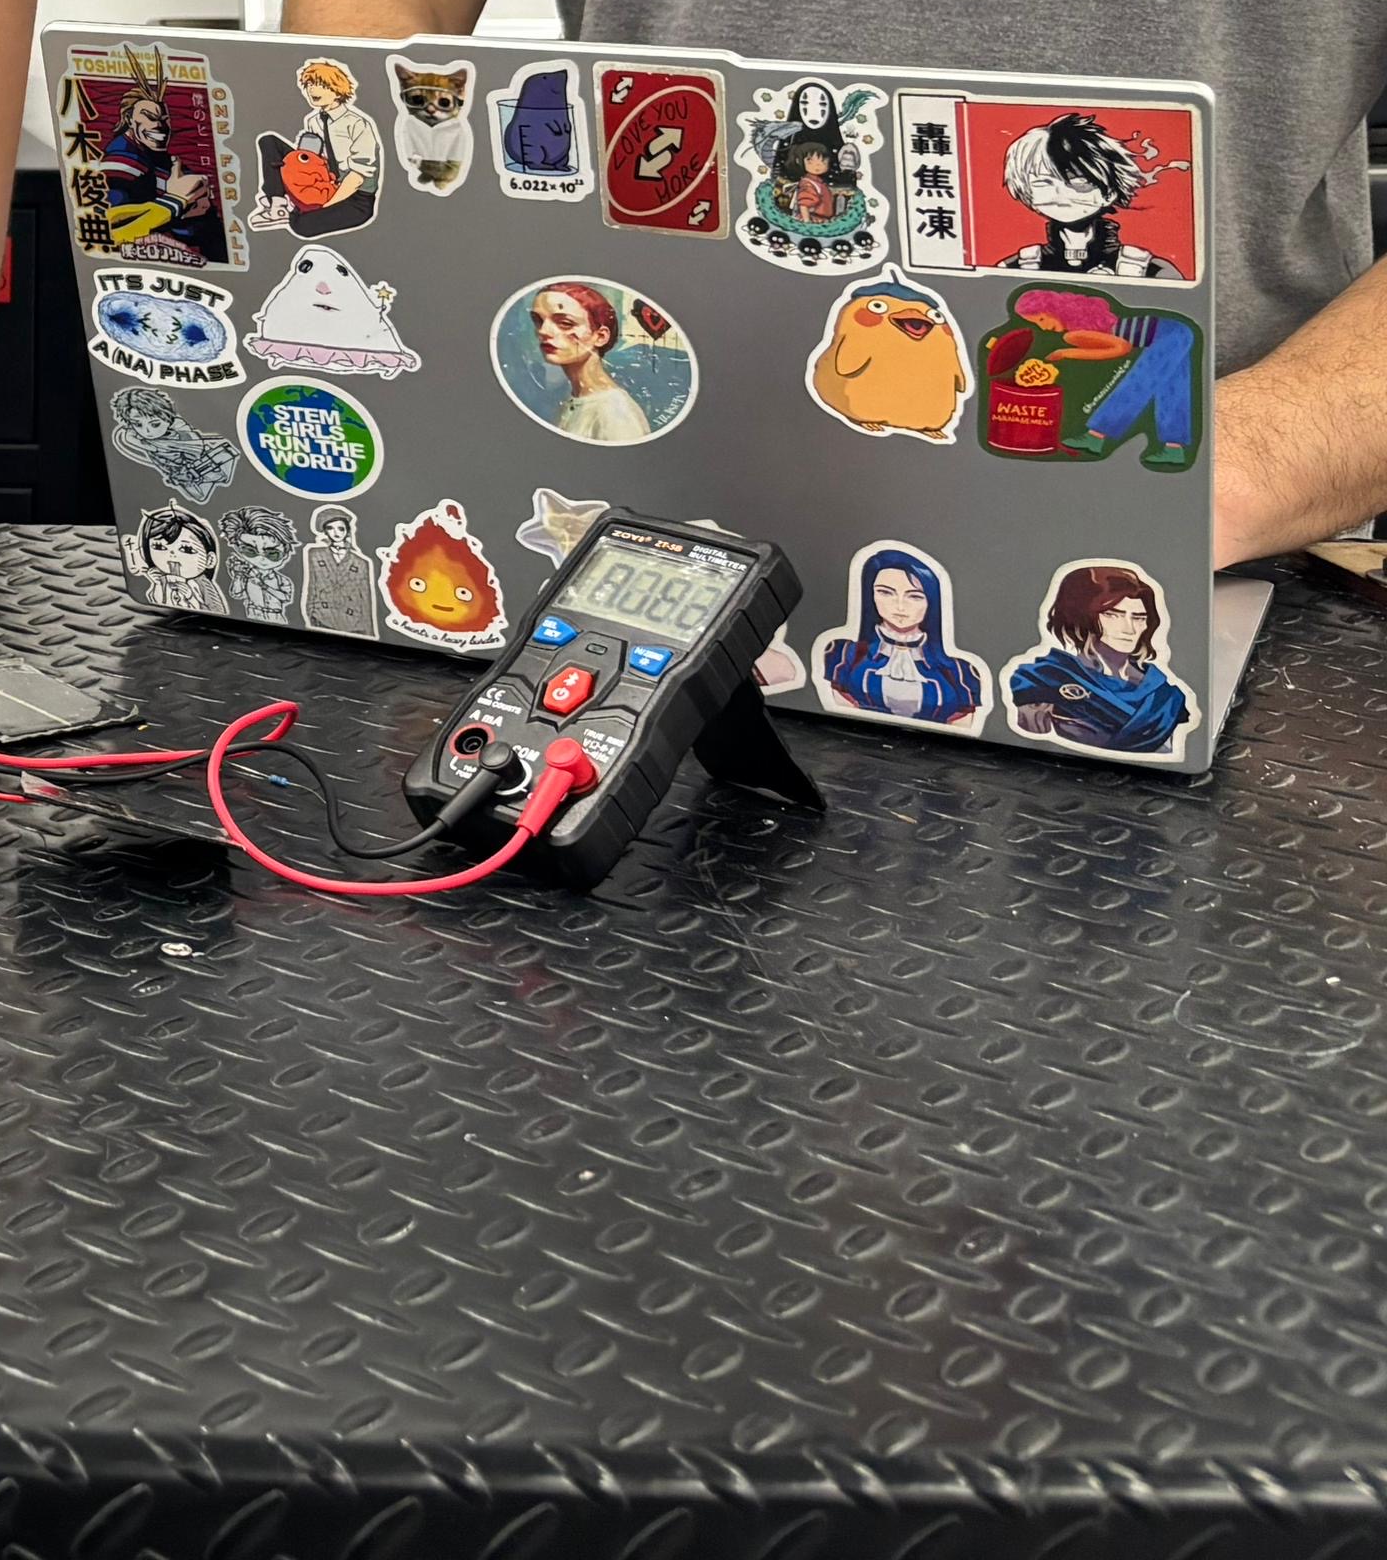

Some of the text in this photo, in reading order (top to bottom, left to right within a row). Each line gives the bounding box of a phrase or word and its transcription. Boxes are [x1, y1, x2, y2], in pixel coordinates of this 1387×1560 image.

[168, 63, 207, 80] YAGI
[212, 87, 230, 136] ONE
[613, 96, 689, 172] LOVE YOU
[220, 154, 239, 201] FOR
[655, 152, 702, 206] MORE
[910, 122, 957, 240] 轟焦凍
[228, 220, 247, 266] ALL
[150, 277, 225, 307] JUST
[160, 361, 239, 383] PHASE
[273, 404, 341, 426] STEM
[992, 414, 1054, 426] MANAGEMENT
[997, 402, 1048, 418] WASTE
[274, 420, 346, 441] GIRLS
[259, 433, 366, 459] RUN THE
[269, 449, 358, 473] WORLD
[688, 551, 748, 572] MULTIMETER
[692, 545, 730, 559] DIGITAL
[469, 709, 504, 728] A mA
